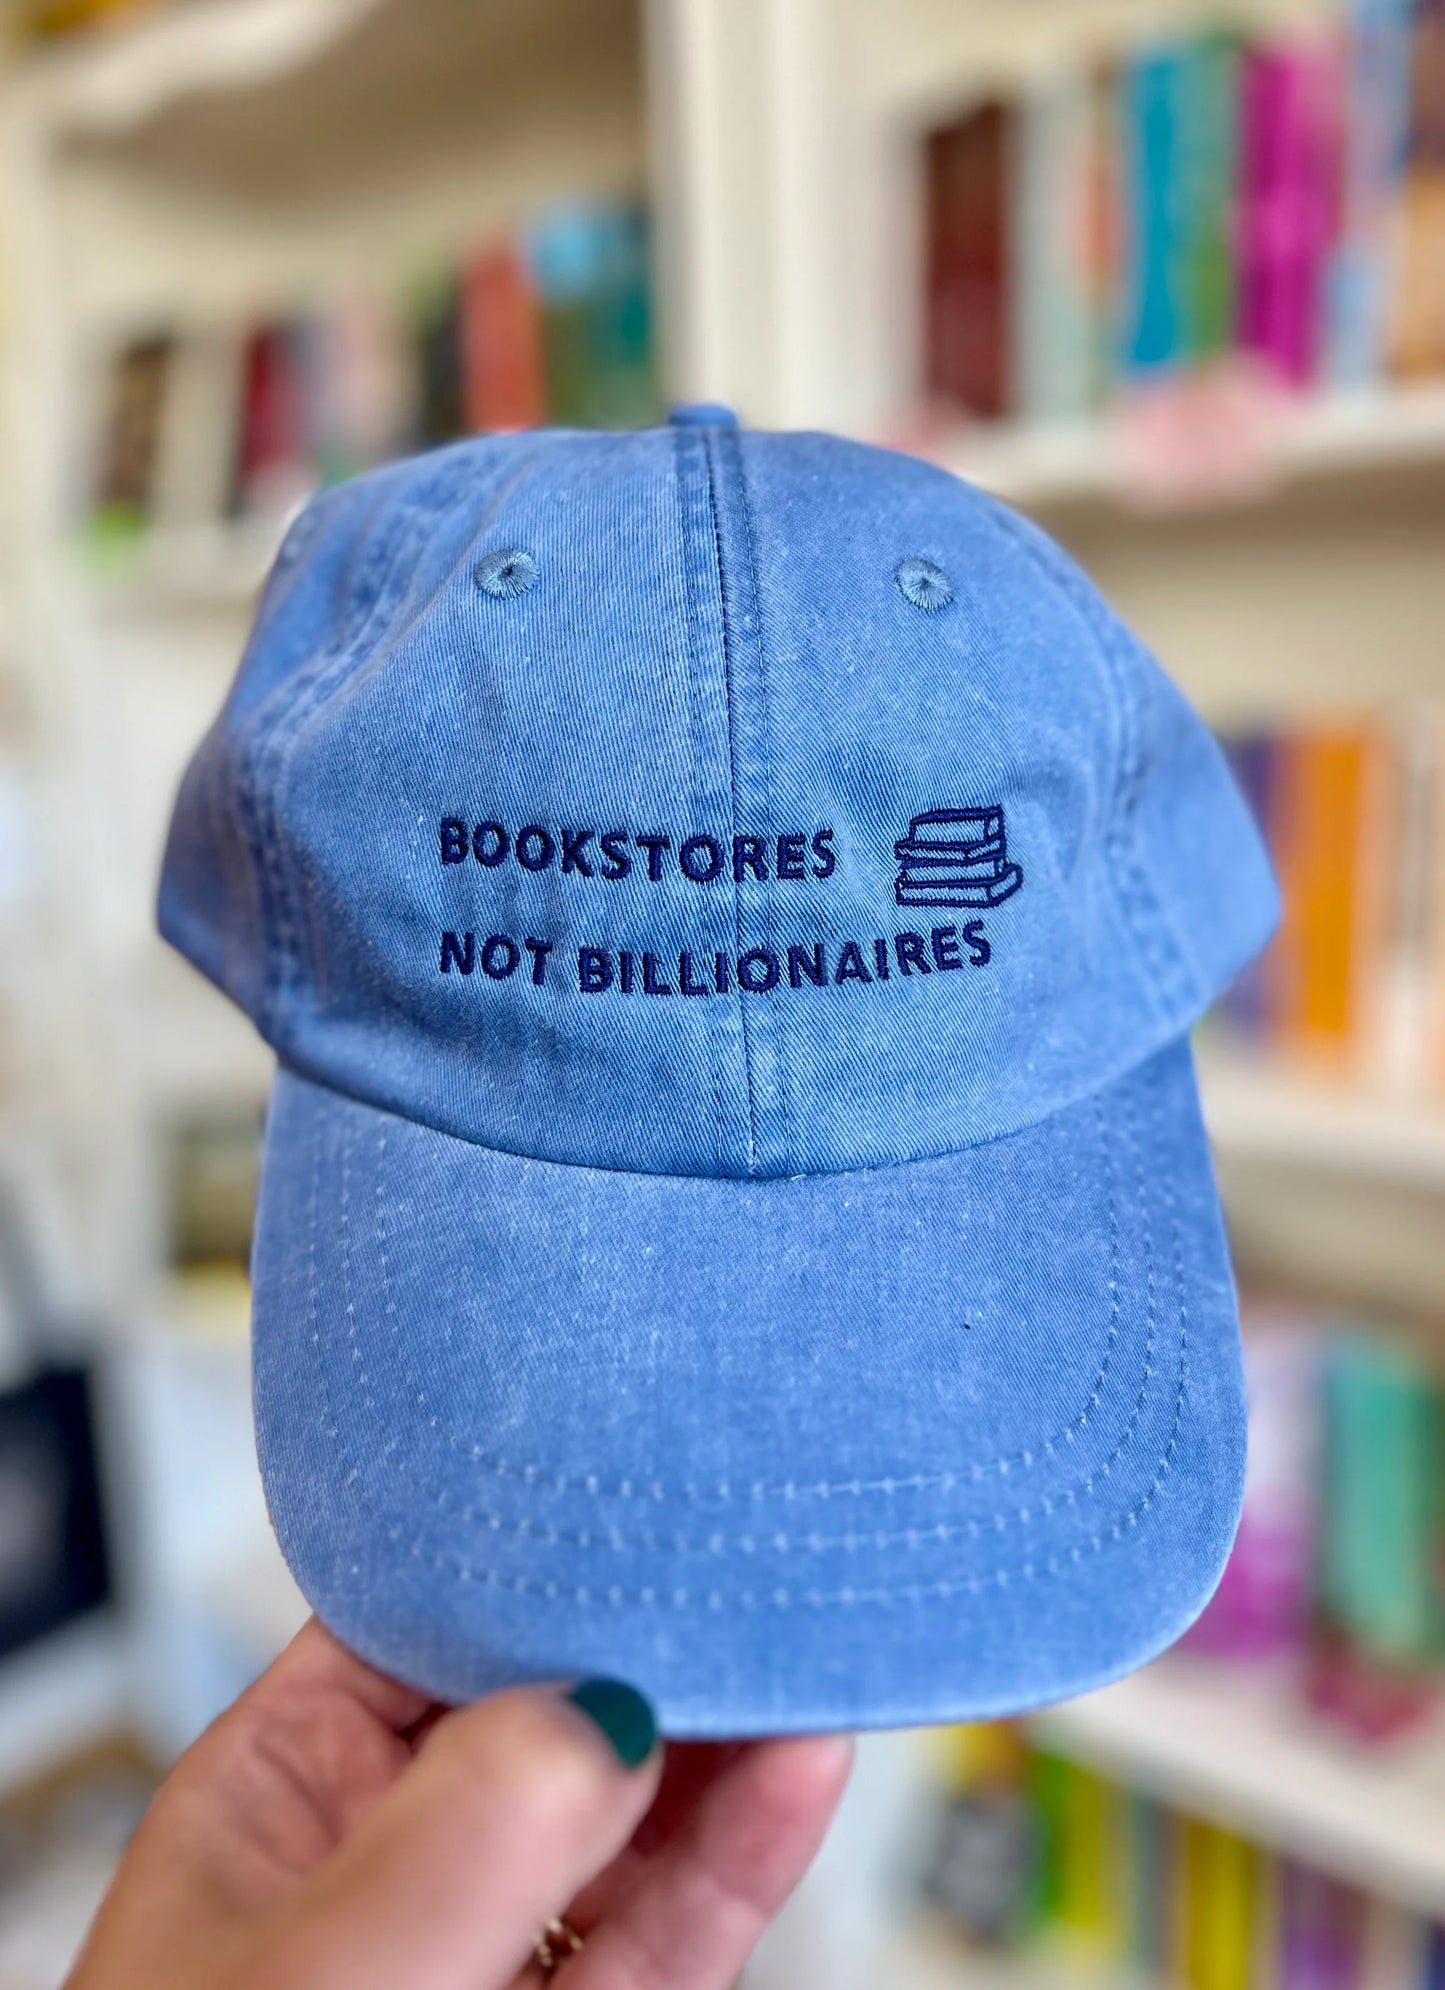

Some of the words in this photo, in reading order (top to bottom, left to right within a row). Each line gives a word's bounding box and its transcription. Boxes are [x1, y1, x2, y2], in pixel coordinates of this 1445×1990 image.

[439, 815, 836, 884] BOOKSTORES
[439, 931, 553, 985] NOT
[577, 919, 991, 996] BILLIONAIRES
